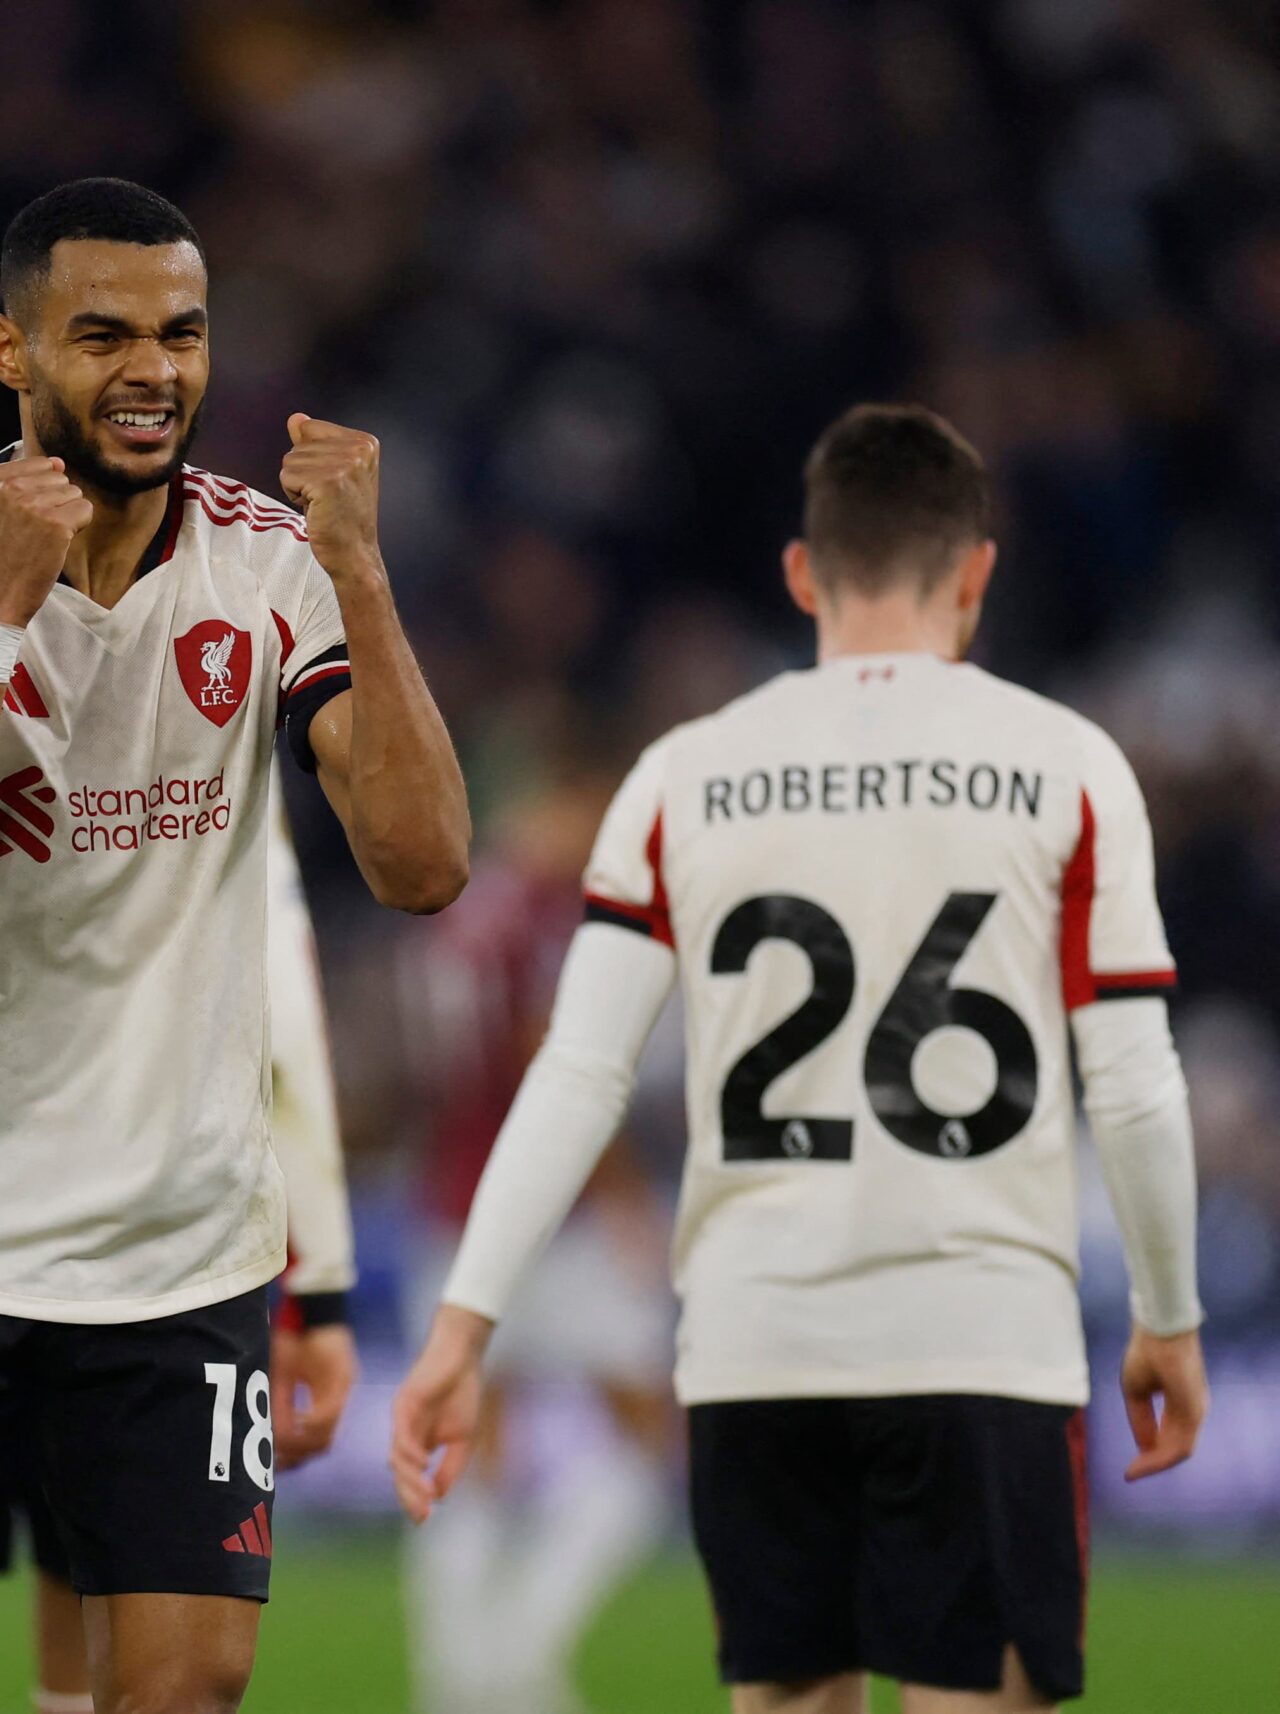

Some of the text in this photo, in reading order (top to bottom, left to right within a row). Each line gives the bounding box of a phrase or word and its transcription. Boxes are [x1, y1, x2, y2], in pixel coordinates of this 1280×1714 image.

[200, 690, 238, 706] L.F.C.
[69, 766, 224, 817] standard
[704, 759, 1043, 824] ROBERTSON
[72, 798, 231, 852] chartered
[709, 891, 1039, 1163] 26
[203, 1362, 275, 1492] 18
